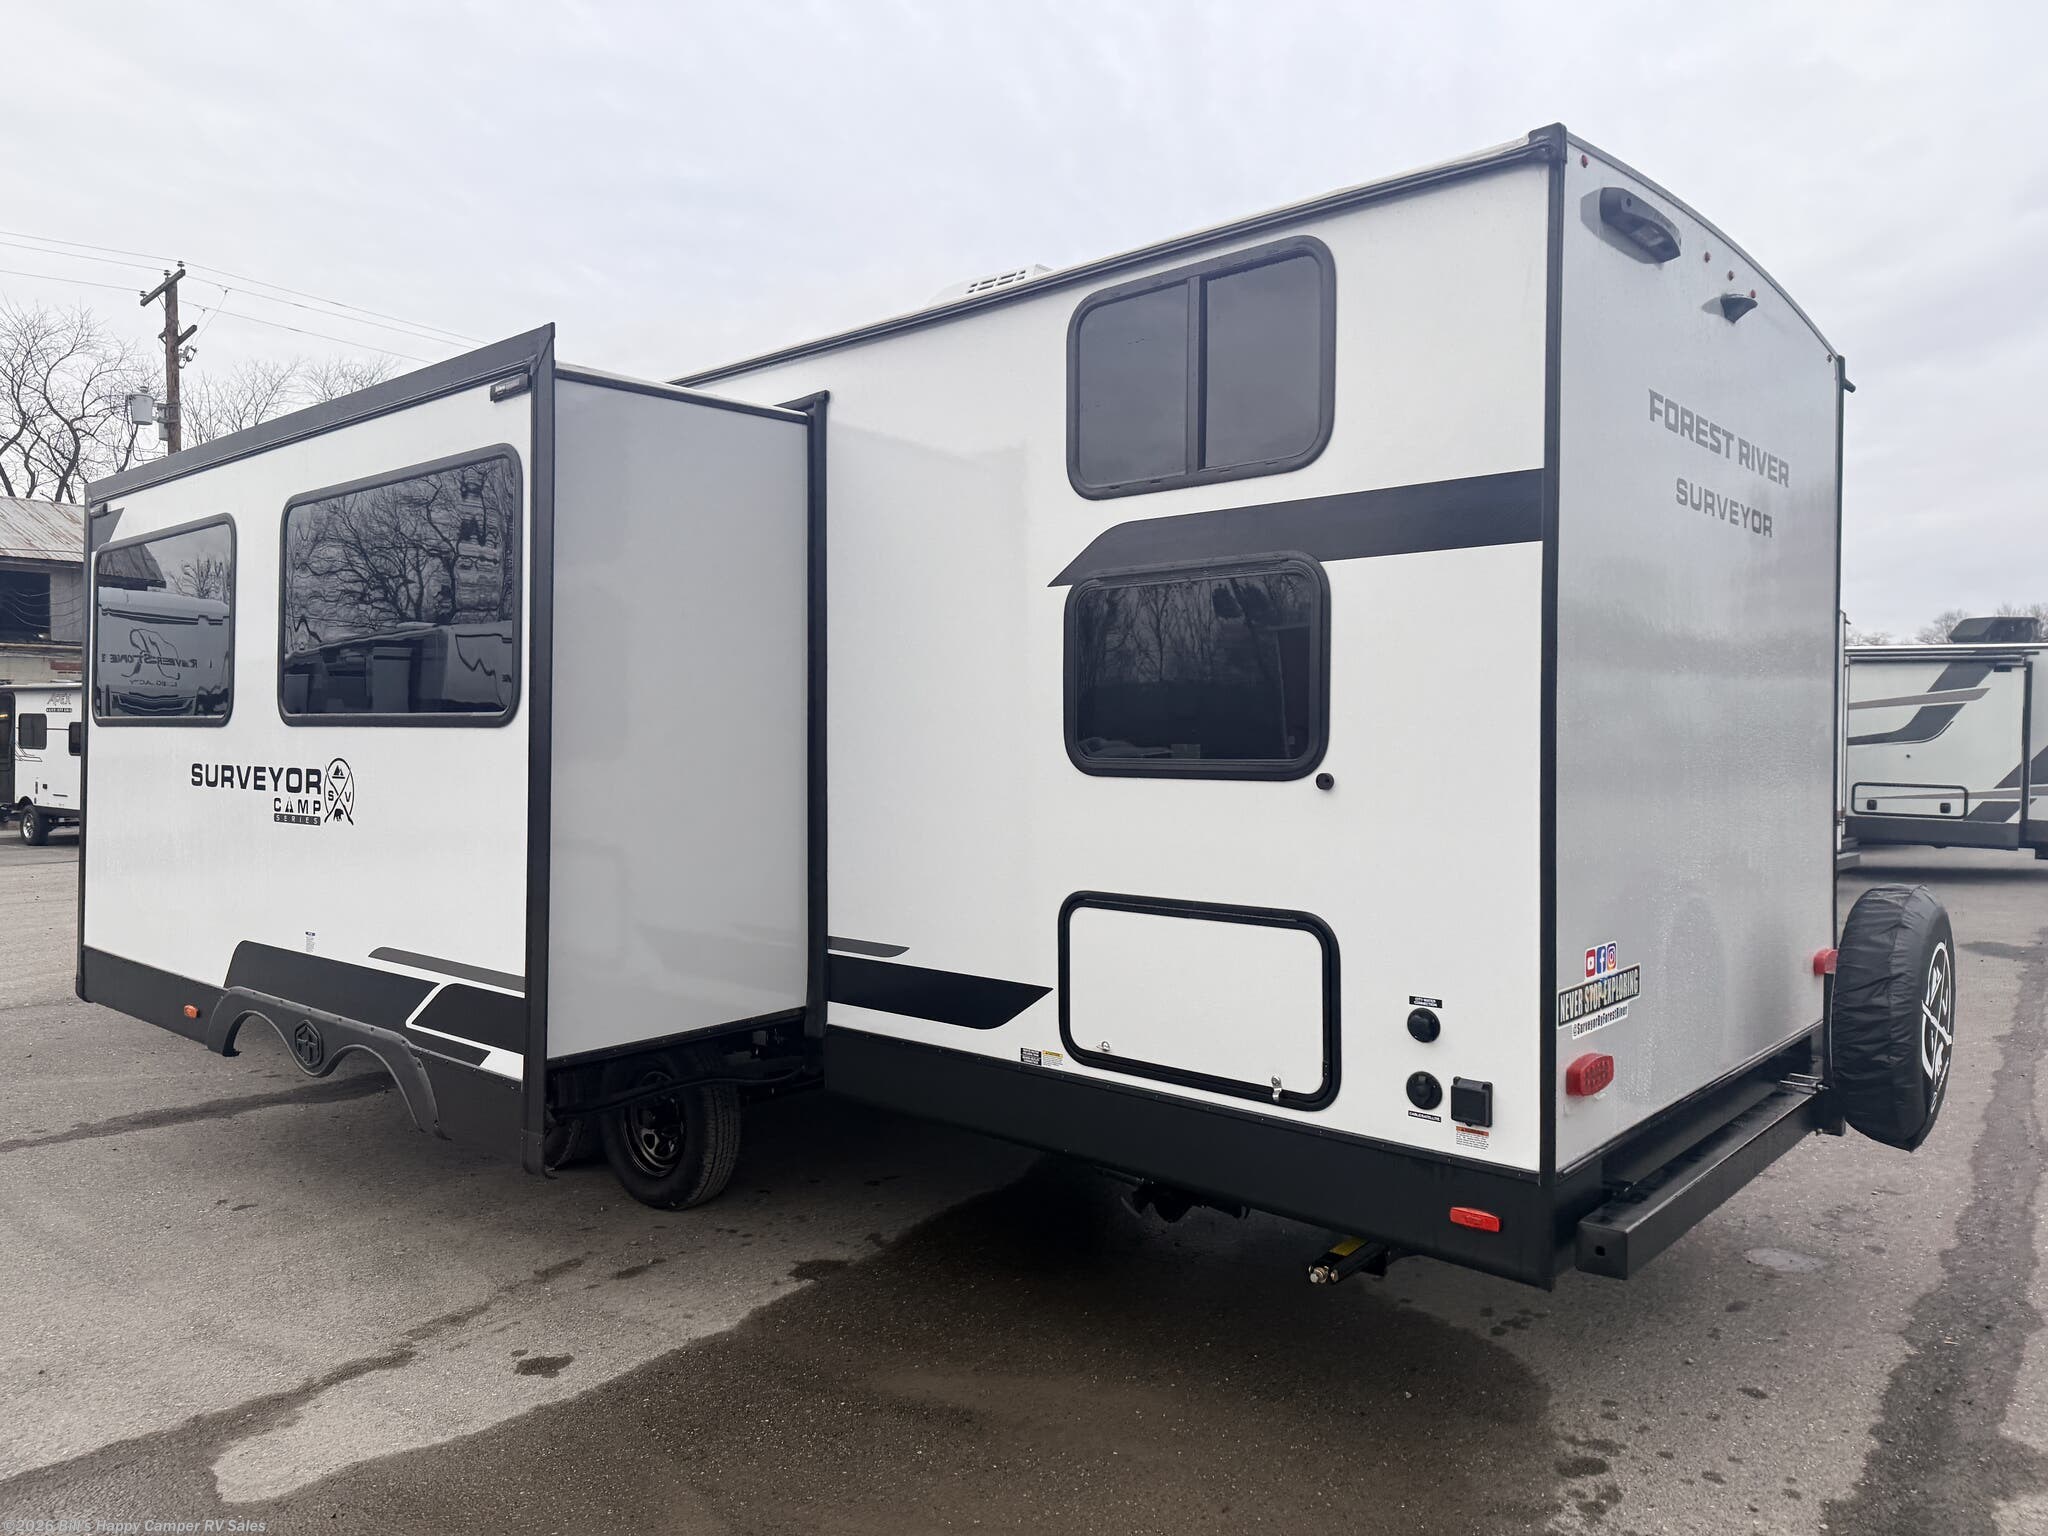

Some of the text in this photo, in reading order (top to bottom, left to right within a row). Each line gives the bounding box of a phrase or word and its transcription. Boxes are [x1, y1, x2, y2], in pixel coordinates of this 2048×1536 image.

[1648, 388, 1790, 488] FOREST RIVER
[1676, 477, 1773, 538] SURVEYOR
[191, 763, 322, 795] SURVEYOR
[273, 797, 321, 815] CAMP
[275, 814, 319, 825] SERIES
[1559, 968, 1639, 1023] NEVER STOP EXPLORING
